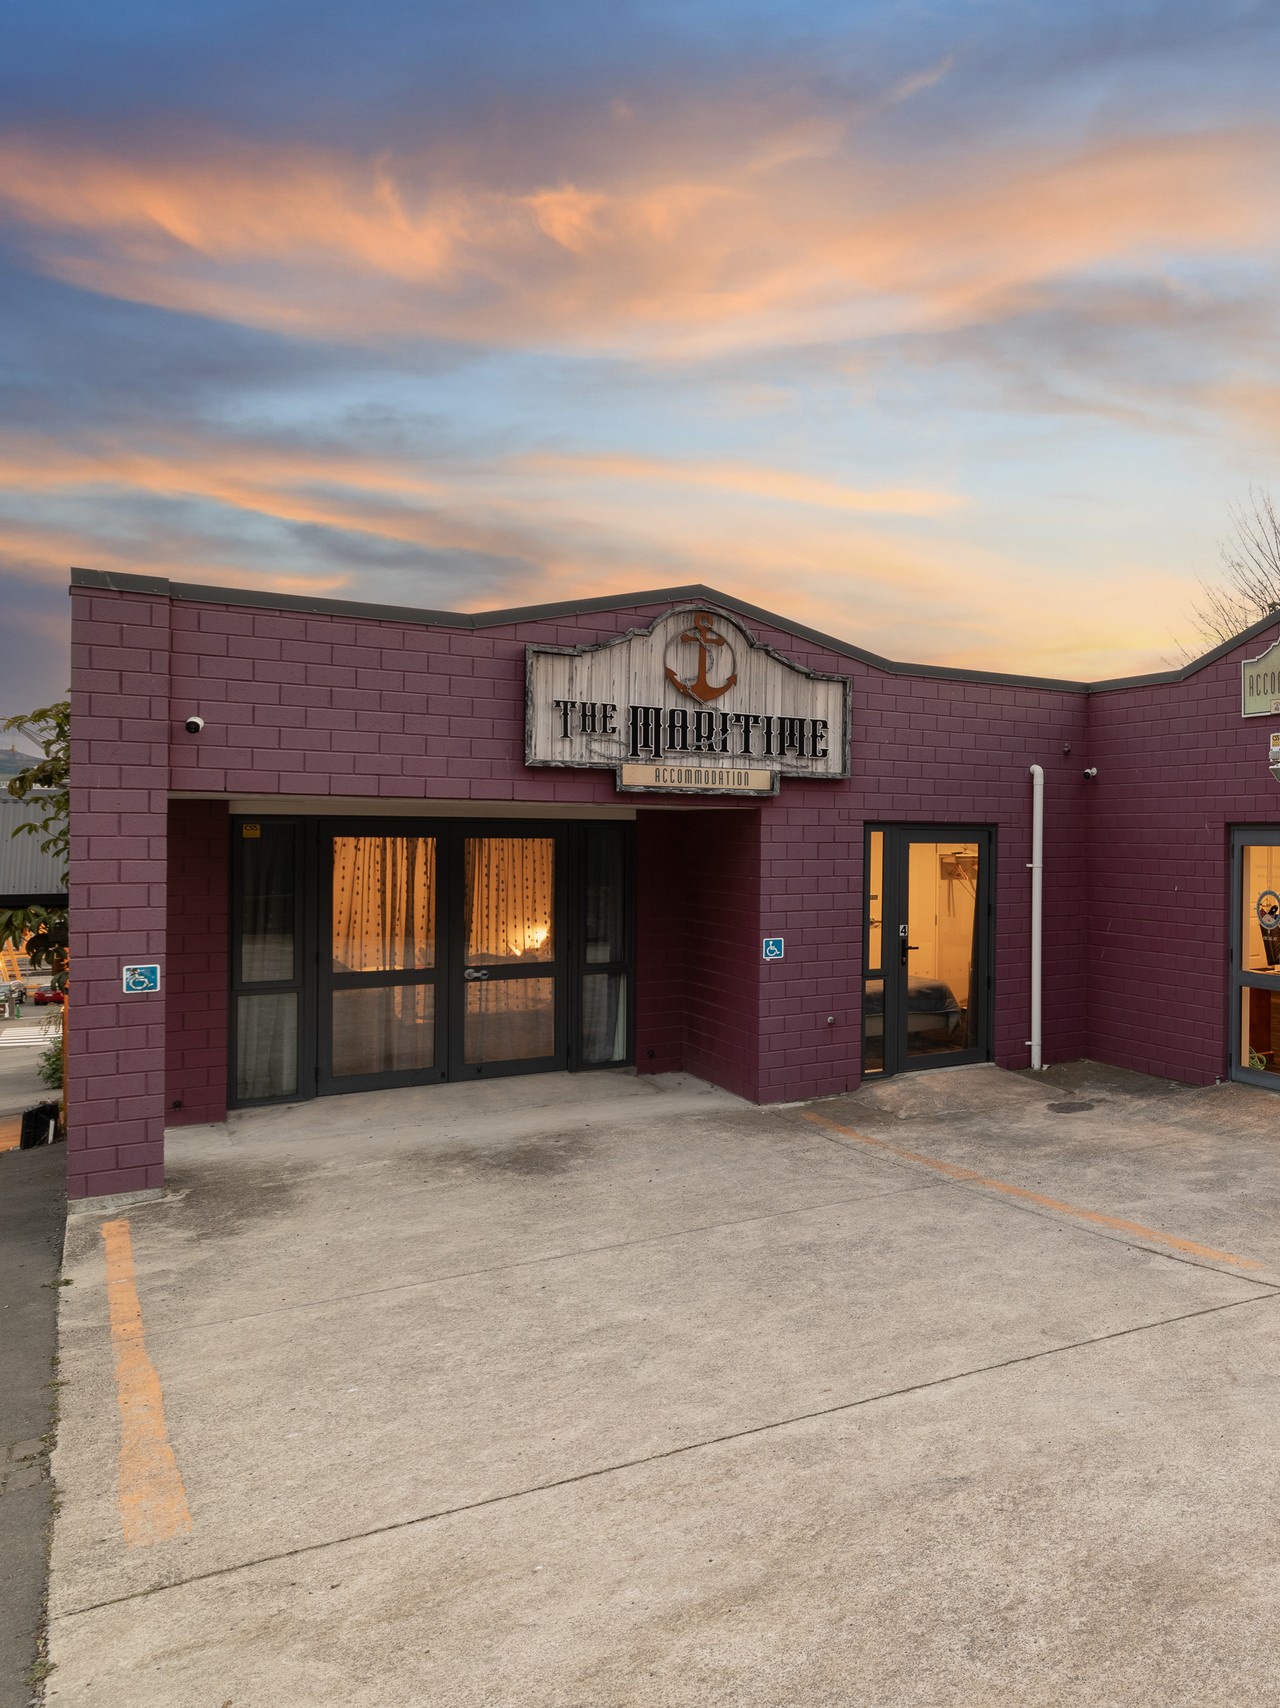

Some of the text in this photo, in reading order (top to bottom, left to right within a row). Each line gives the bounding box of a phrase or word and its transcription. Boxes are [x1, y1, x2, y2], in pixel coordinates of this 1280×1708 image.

[553, 699, 829, 760] THE MARITIME
[655, 767, 750, 787] ACCOMMODATION
[900, 925, 907, 935] 4
